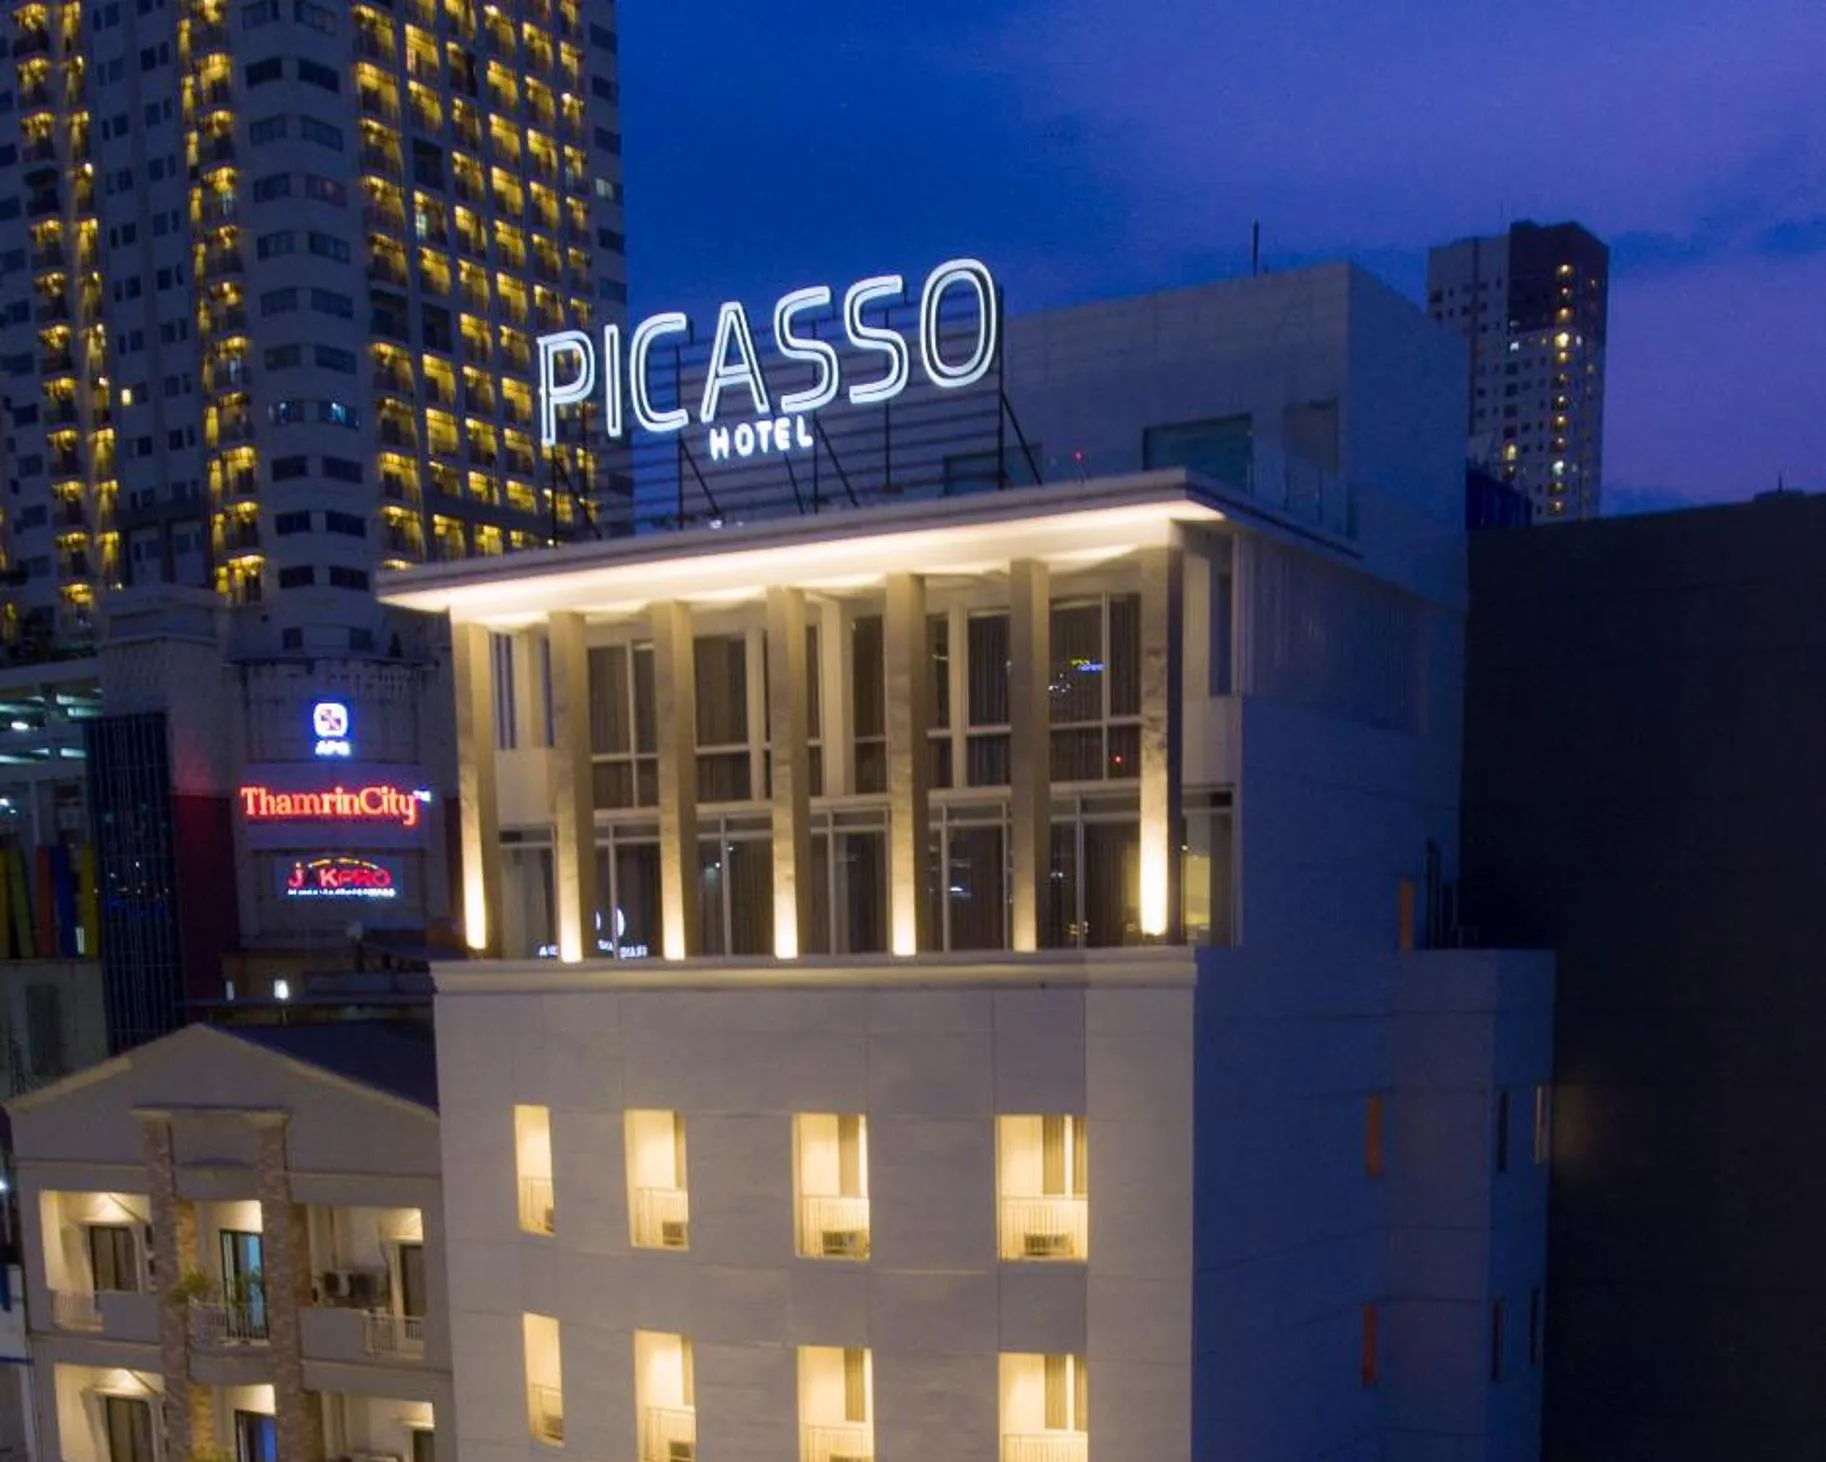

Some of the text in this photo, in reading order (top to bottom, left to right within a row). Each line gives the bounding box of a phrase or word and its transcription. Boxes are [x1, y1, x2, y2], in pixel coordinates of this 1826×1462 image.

[537, 258, 998, 446] PICASSO
[709, 415, 813, 461] HOTEL
[239, 786, 417, 826] ThamrinCity
